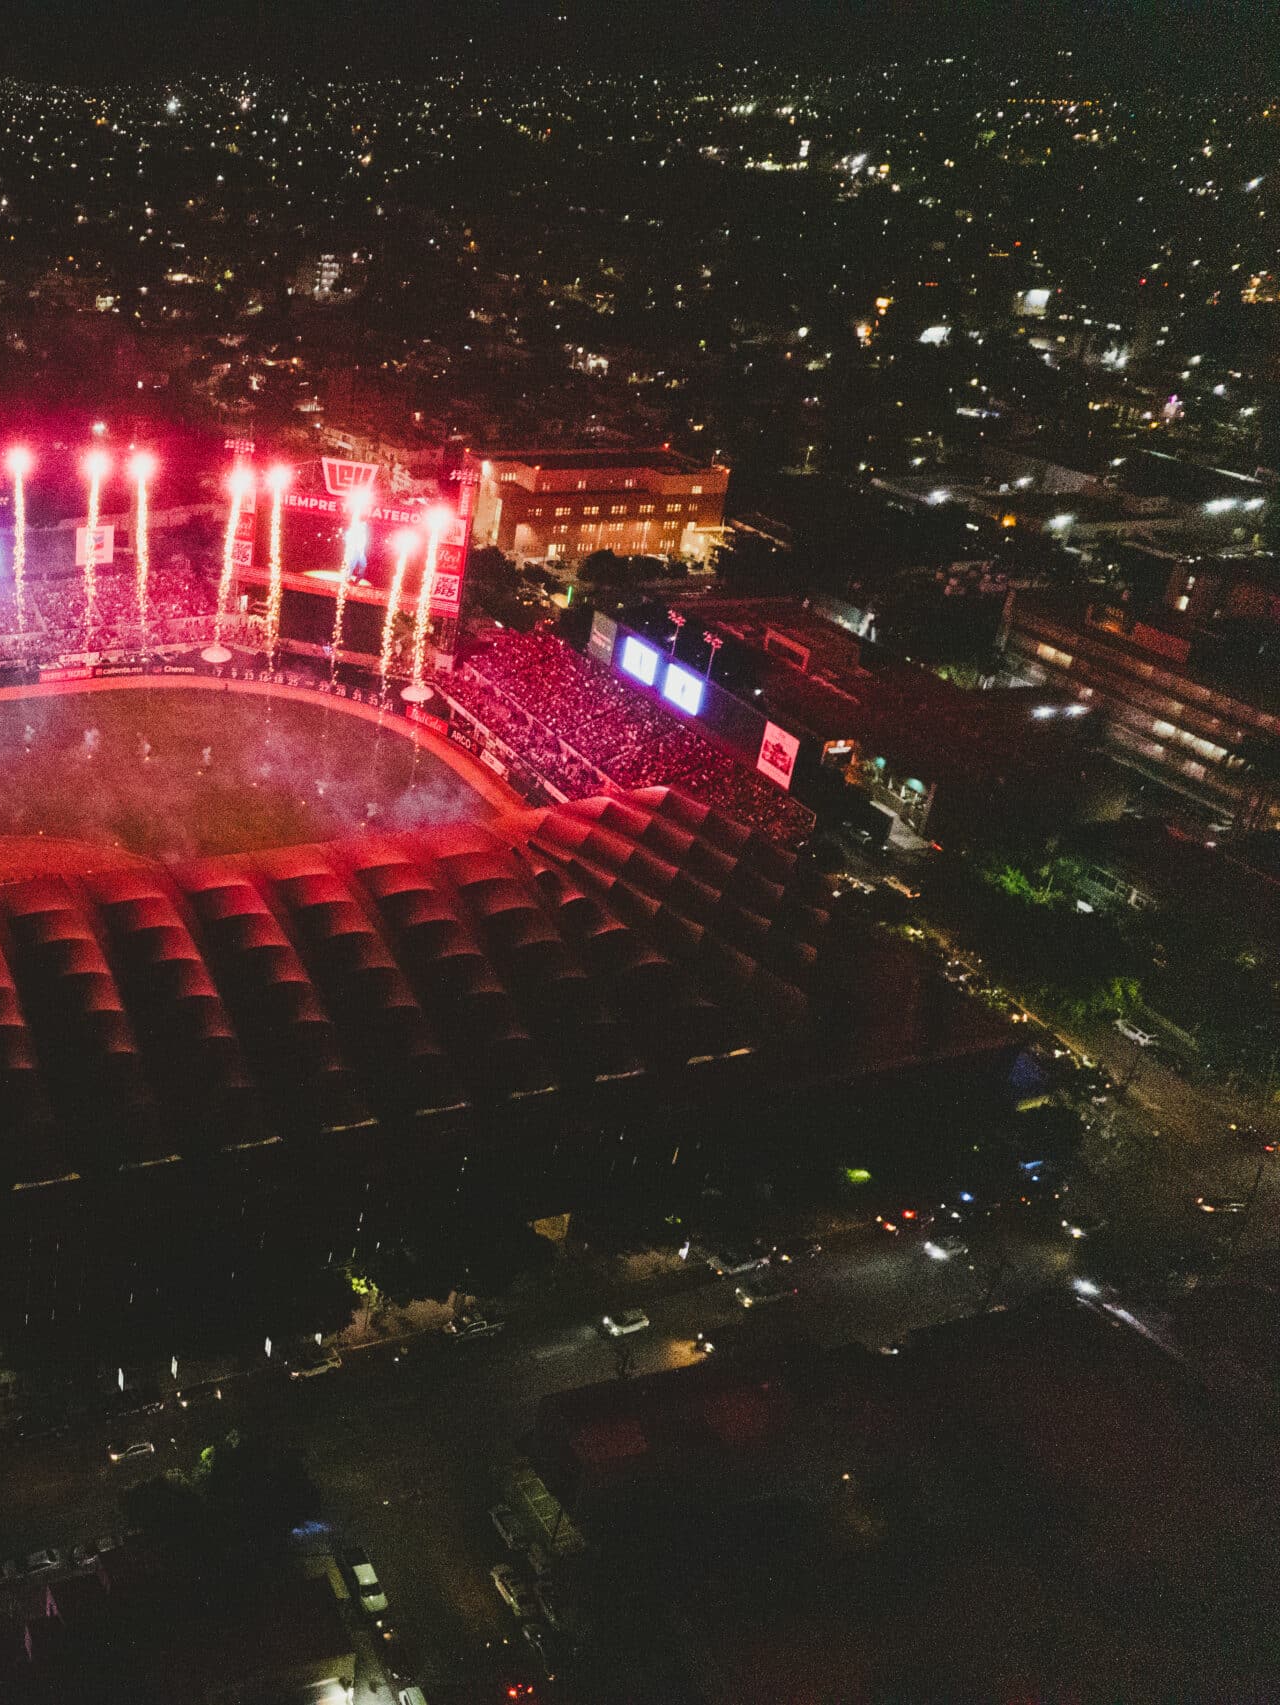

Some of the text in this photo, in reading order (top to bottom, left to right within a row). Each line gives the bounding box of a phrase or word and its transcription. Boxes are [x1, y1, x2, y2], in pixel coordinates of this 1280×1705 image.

[281, 495, 336, 512] IEMPRE
[163, 665, 195, 673] Chevron
[451, 730, 471, 749] ARCO
